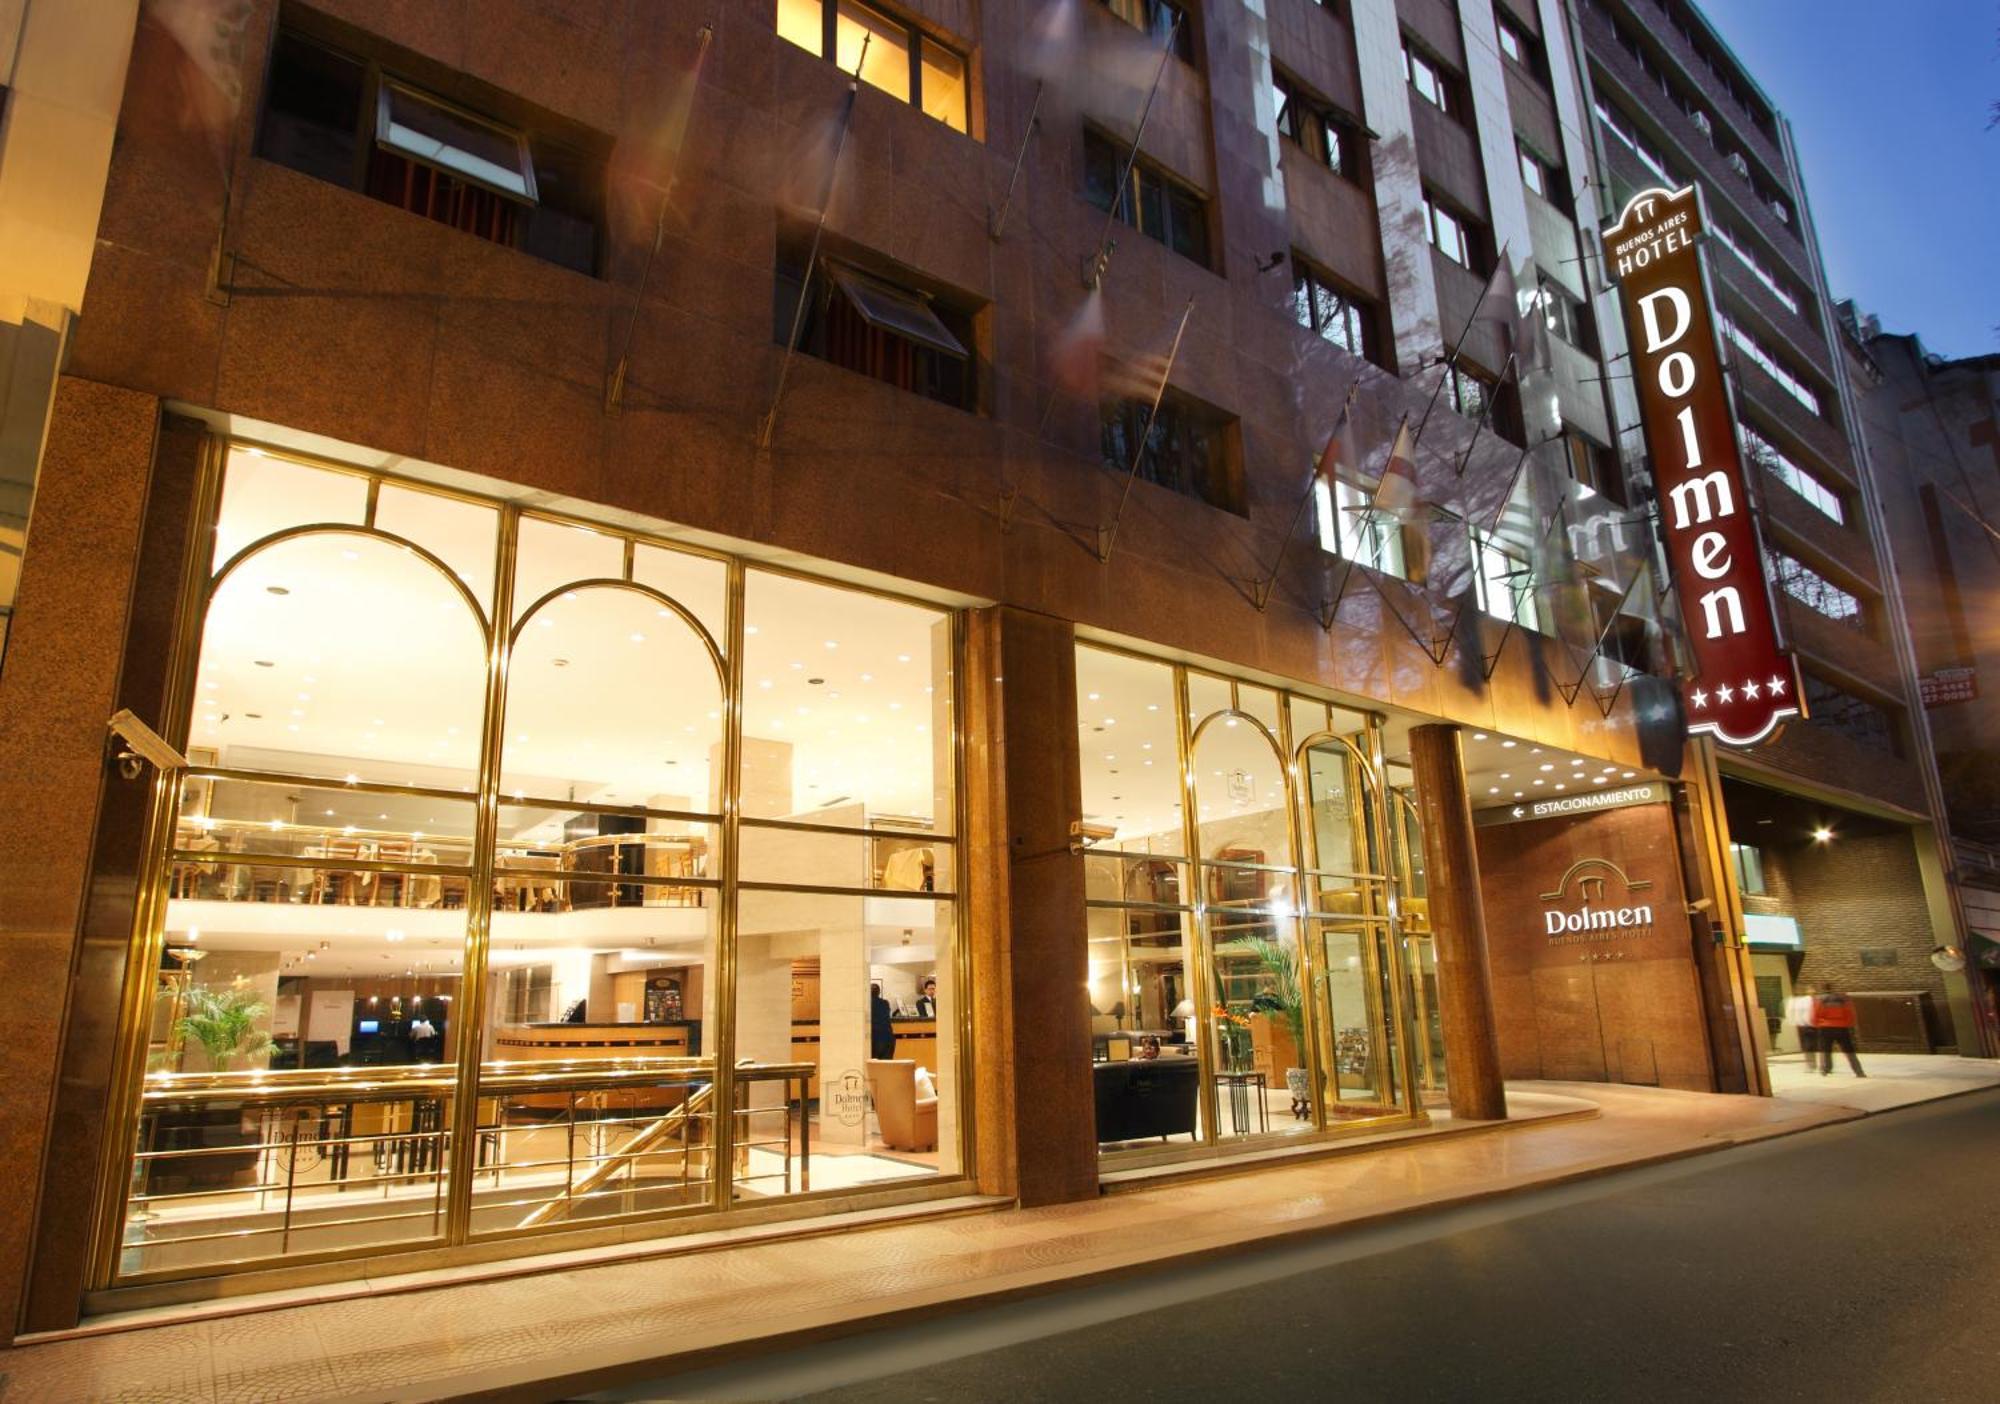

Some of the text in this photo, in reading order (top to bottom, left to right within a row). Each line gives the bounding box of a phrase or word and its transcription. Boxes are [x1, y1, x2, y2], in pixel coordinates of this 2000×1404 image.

[1616, 211, 1688, 255] BUENOS AIRES
[1618, 227, 1692, 277] HOTEL
[1637, 286, 1746, 639] Dolmen
[1533, 787, 1652, 815] ESTACIONAMIENTO
[1544, 904, 1653, 935] Dolmen
